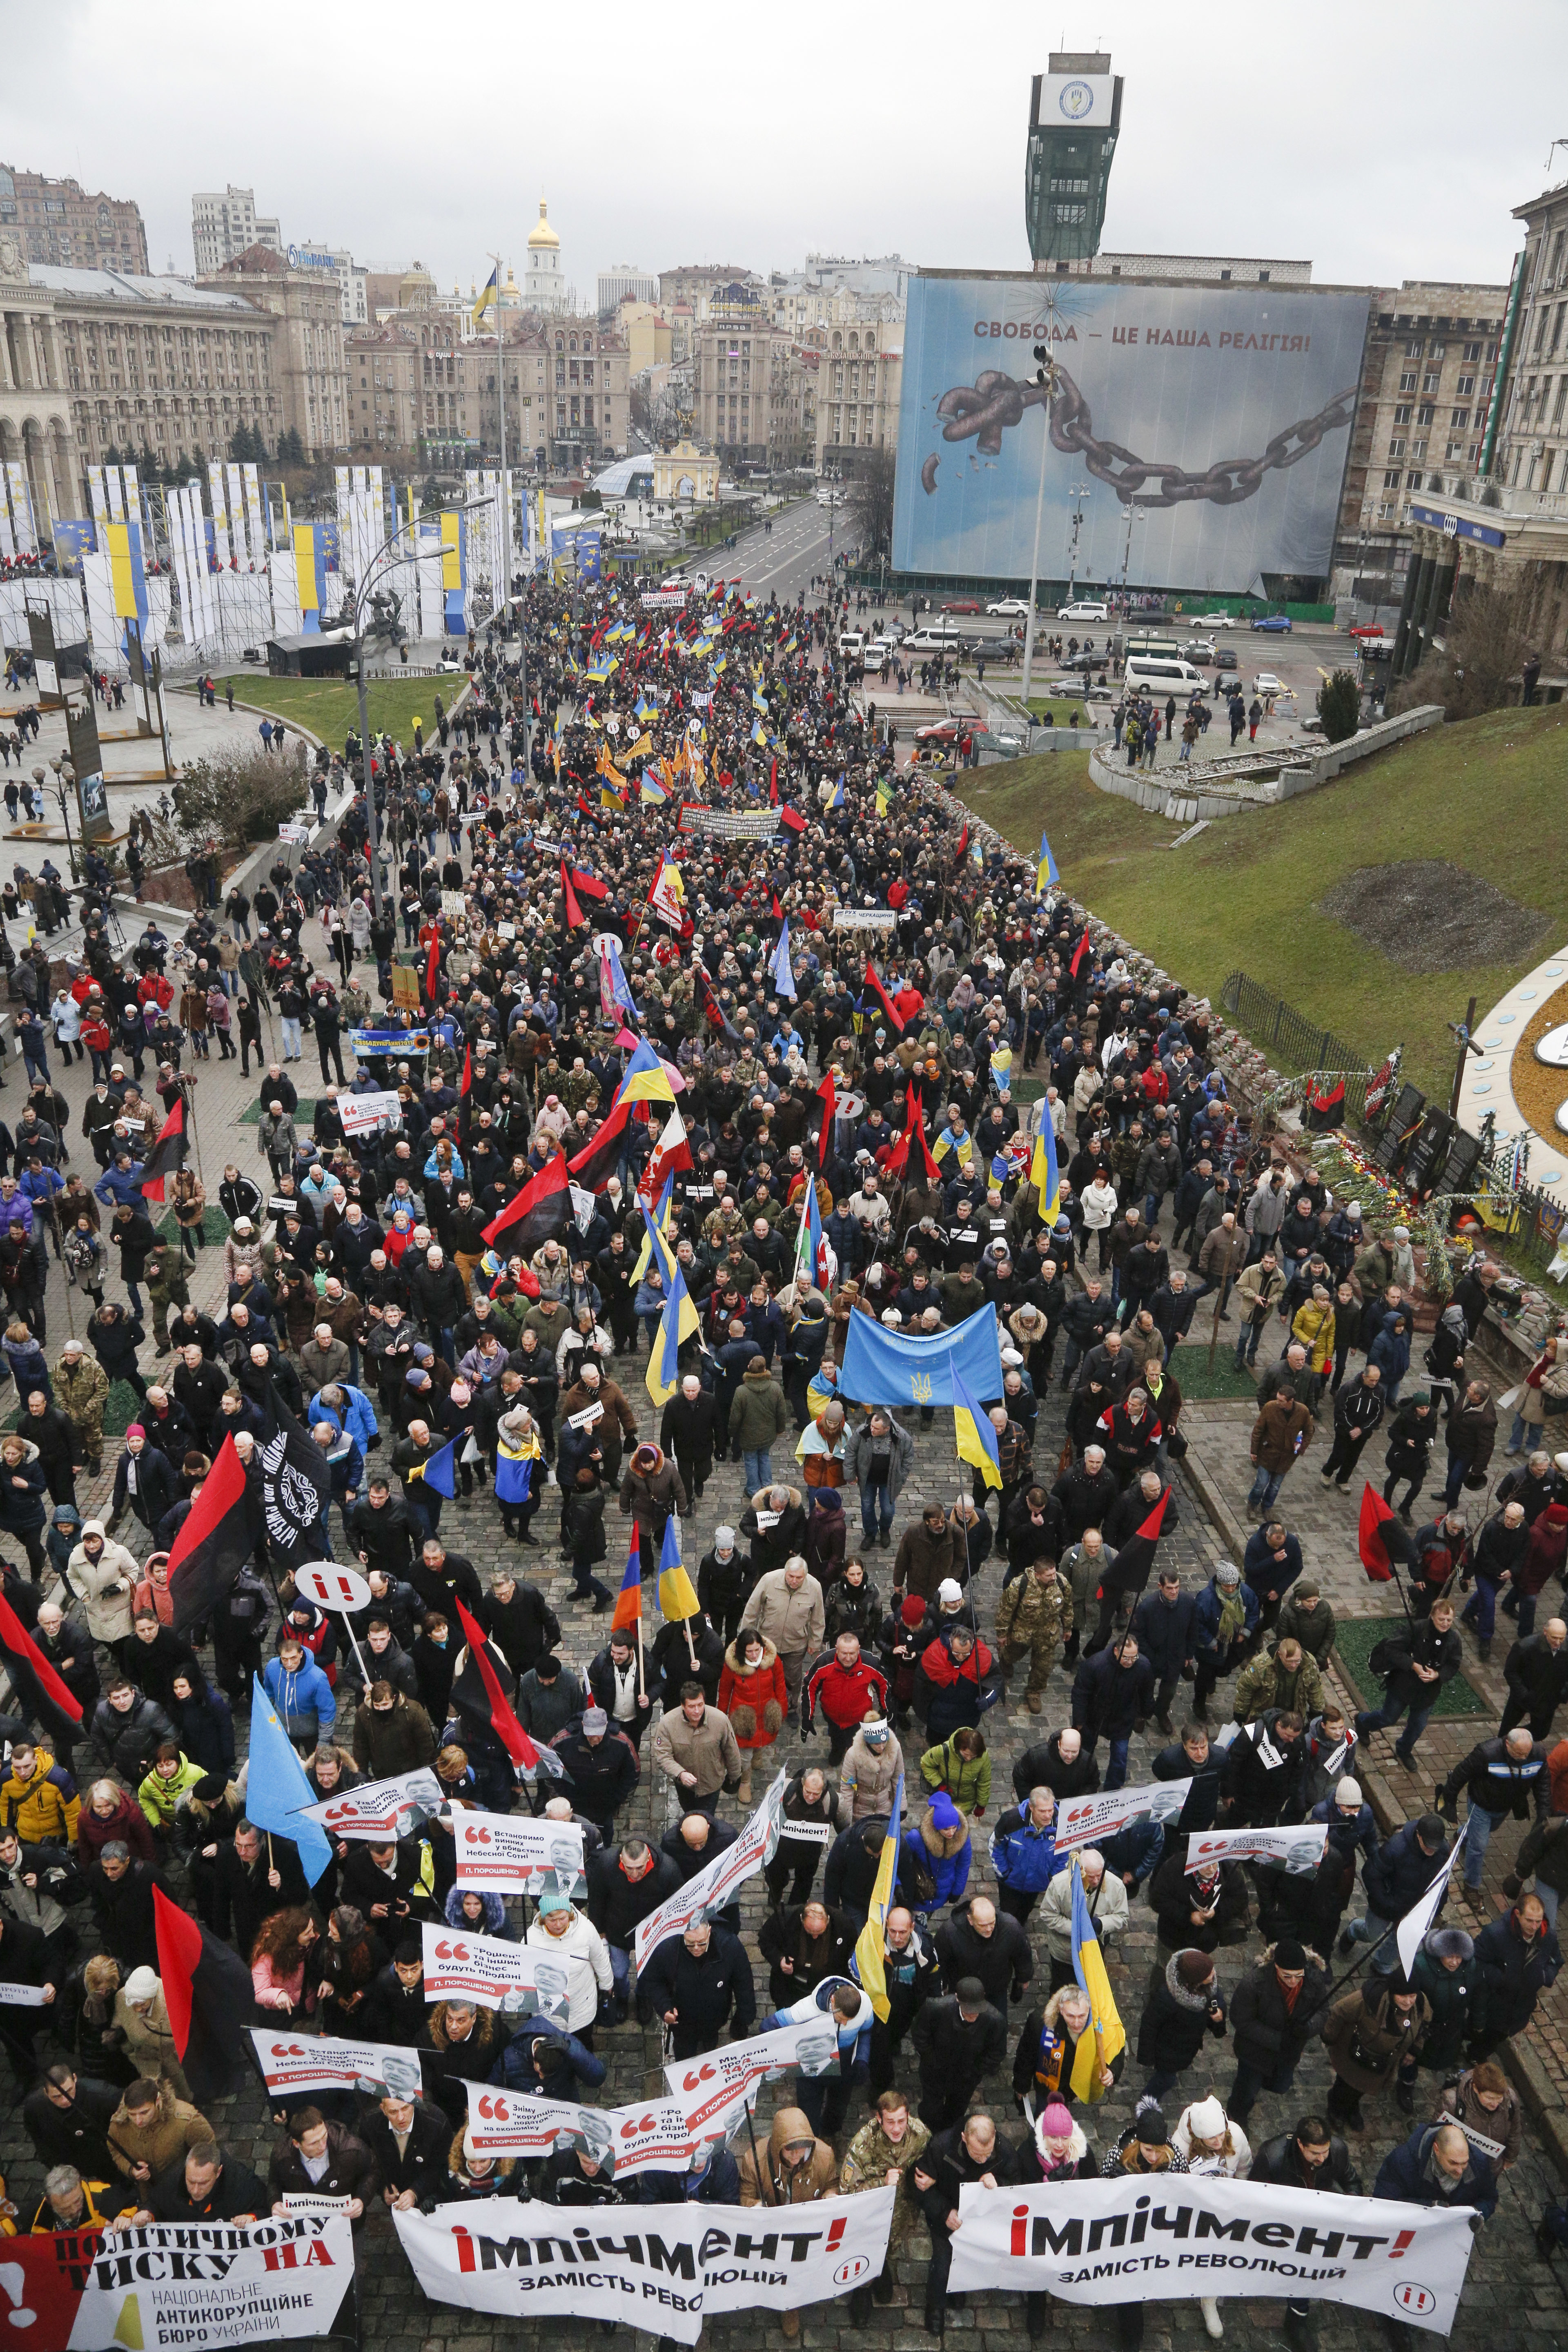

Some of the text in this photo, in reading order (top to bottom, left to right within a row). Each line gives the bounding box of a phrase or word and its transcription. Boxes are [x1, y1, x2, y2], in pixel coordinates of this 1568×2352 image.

[973, 322, 1078, 343] СВОБОДА
[1112, 326, 1138, 346] ЦЕ
[1146, 328, 1212, 348] НАША
[1219, 331, 1311, 352] РЕЛІГІЯ!
[352, 1119, 374, 1127] ПОРОШЕНКО
[571, 1405, 601, 1425] імпічмент!
[354, 1788, 397, 1805] Ухвалимо
[359, 1793, 399, 1810] закон про
[1097, 1795, 1149, 1813] триватиме
[1098, 1798, 1119, 1807] АТО
[361, 1796, 404, 1815] імпічмент!
[782, 1824, 828, 1836] мпічмент!
[1075, 1817, 1108, 1833] години
[494, 1831, 544, 1841] Встановимо
[1071, 1824, 1116, 1842] ПОРОШЕНКО
[495, 1838, 524, 1846] винних
[502, 1845, 544, 1854] вбивствах
[507, 1851, 528, 1860] Сотні
[474, 1867, 519, 1875] ПОРОШЕНКО
[719, 1853, 756, 1890] ПОРОШЕНКО
[474, 1947, 521, 1959] “Рошен”
[474, 1960, 507, 1971] бізнес
[487, 1957, 521, 1966] інший
[439, 1964, 521, 1980] будуть продані
[445, 1980, 495, 1993] ПОРОШЕНКО
[288, 2071, 346, 2080] ПОРОШЕНКО
[696, 2071, 754, 2123] П. ПОРОШЕНКО
[512, 2109, 571, 2120] “корупційний
[513, 2104, 535, 2114] Зніму
[514, 2114, 553, 2125] податок”
[624, 2134, 663, 2149] будуть
[631, 2149, 686, 2162] ПОРОШЕНКО
[286, 2199, 349, 2208] імпічмент!
[54, 2216, 330, 2261] ПОЛІТИЧНОМУ
[59, 2239, 336, 2290] ТИСКУ НА
[1058, 2254, 1346, 2283] ЗАМІСТЬ РЕВОЛЮЦІЙ
[519, 2272, 635, 2294] ЗАМІСТЬ
[152, 2282, 263, 2307] НАЦІОНАЛЬНЕ
[156, 2292, 314, 2324] АНТИКОРУПЦІЙНЕ
[159, 2316, 280, 2345] БЮРО УКРАЇНИ
